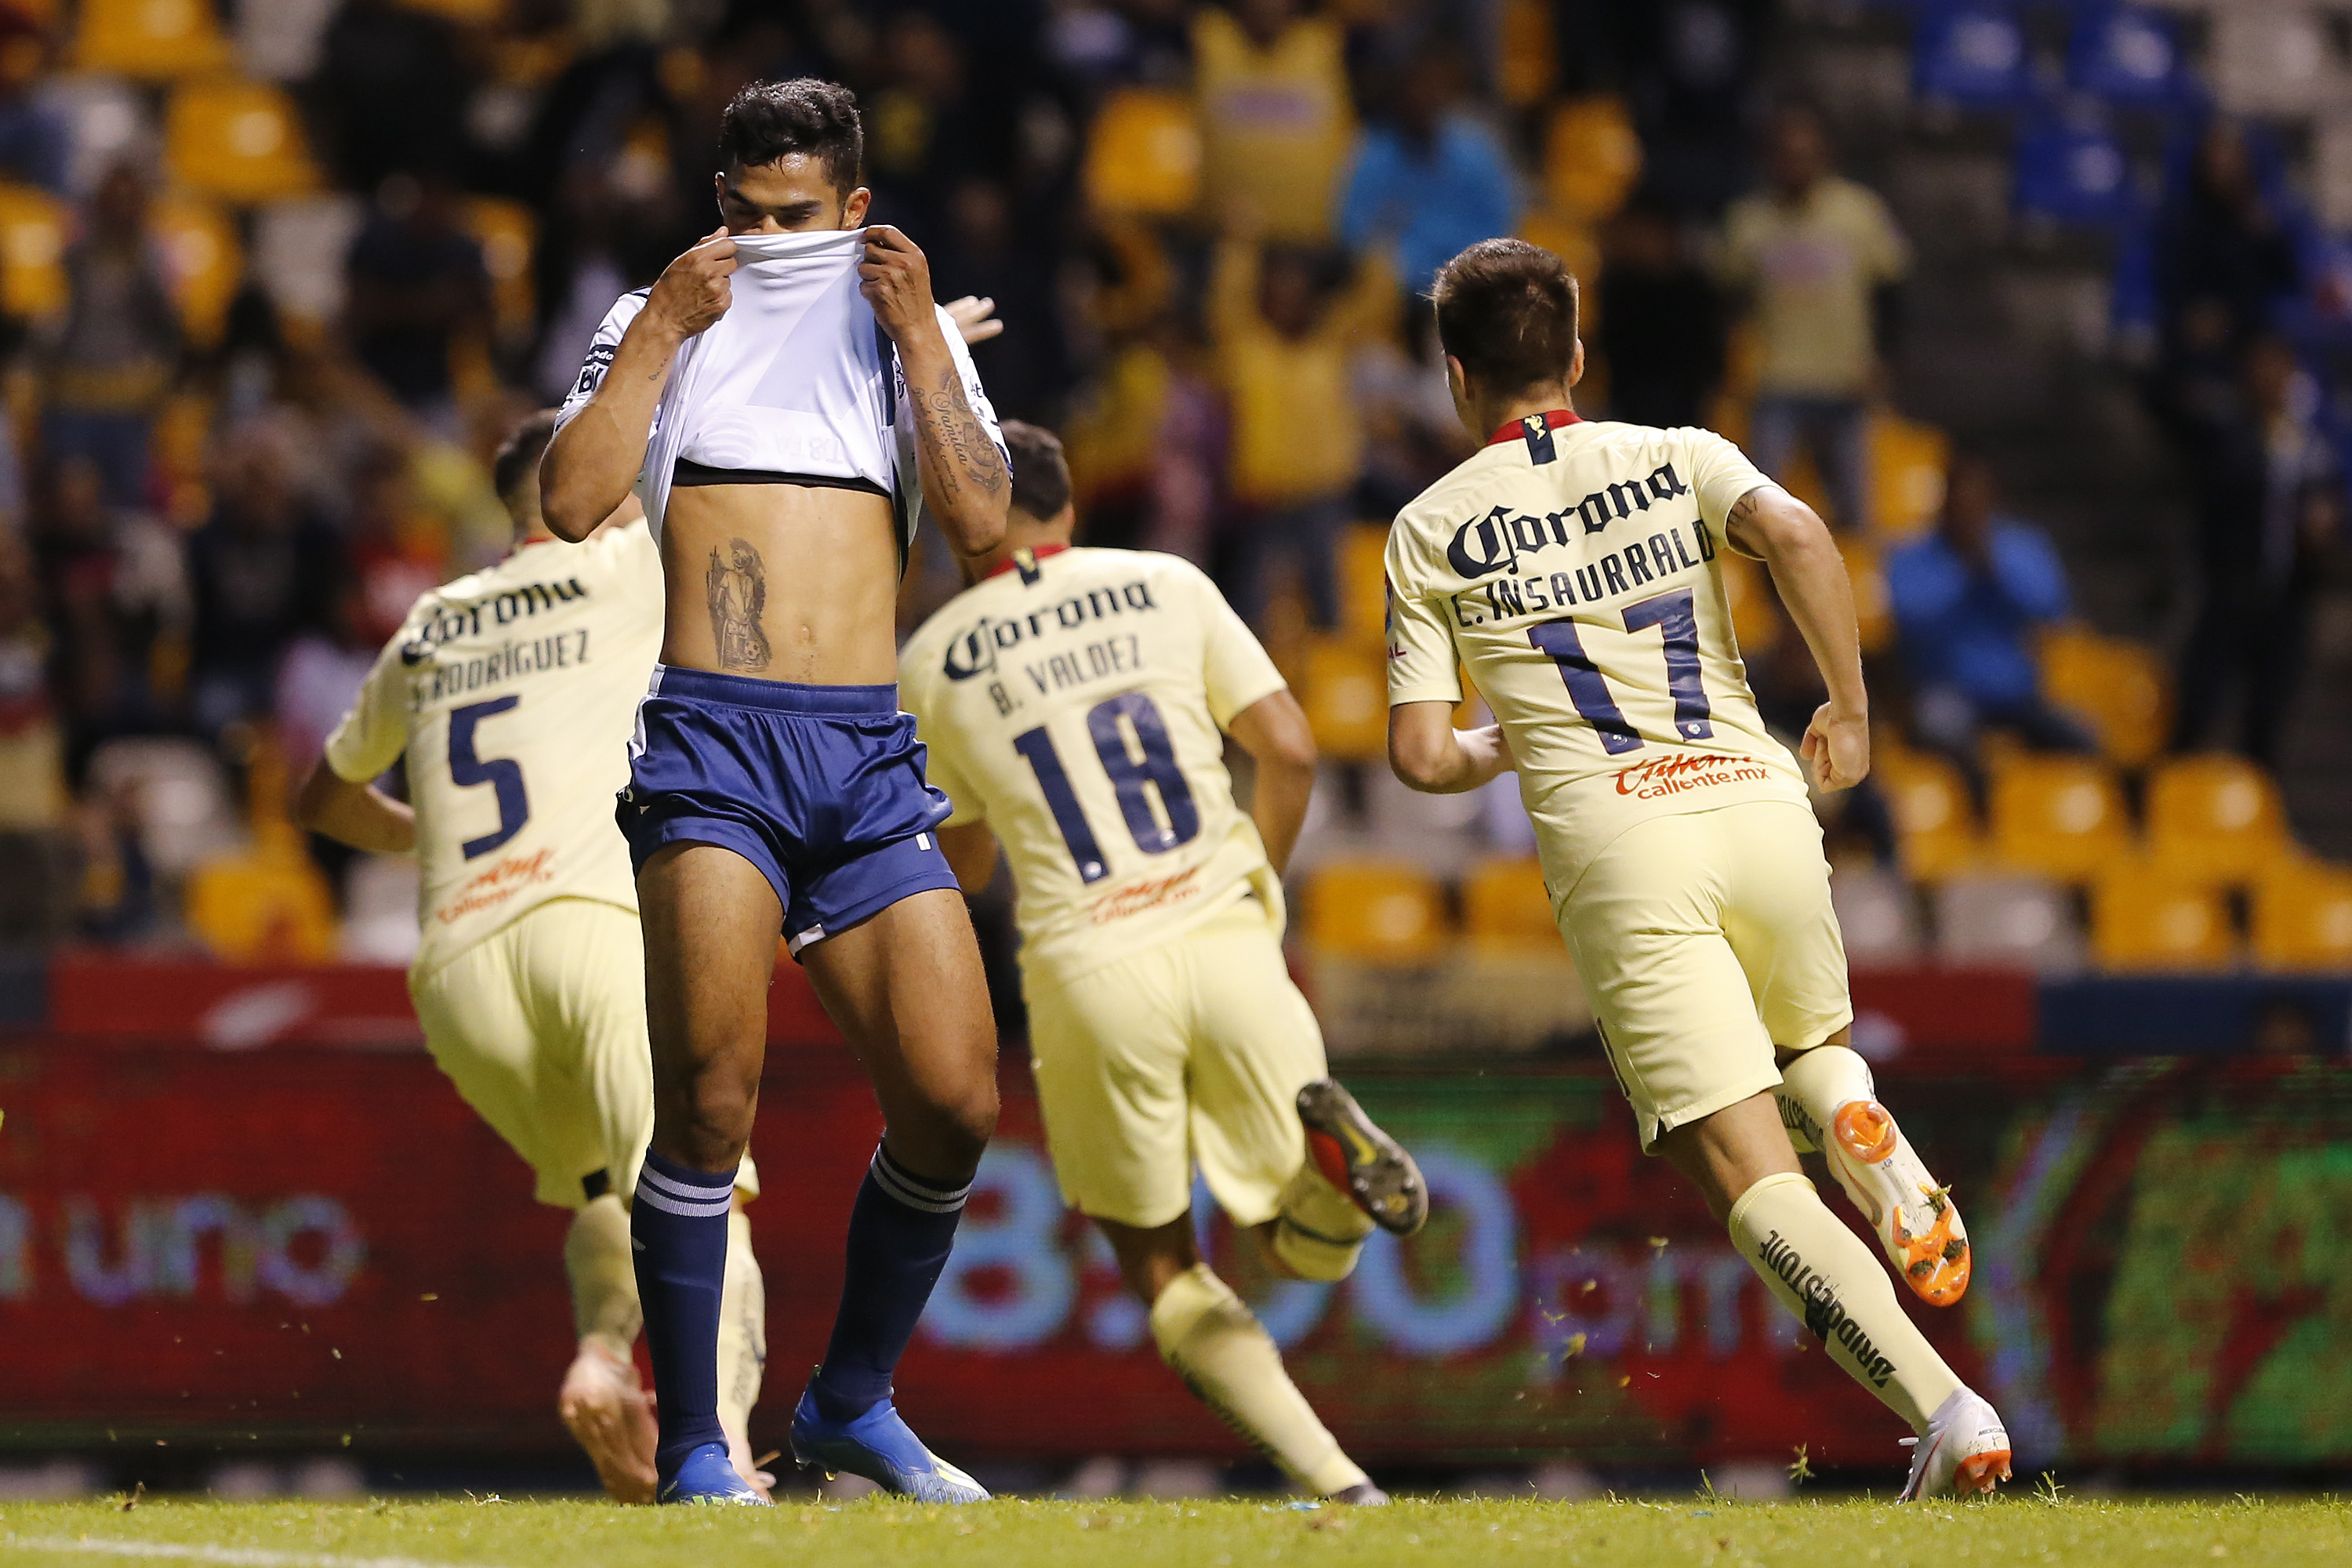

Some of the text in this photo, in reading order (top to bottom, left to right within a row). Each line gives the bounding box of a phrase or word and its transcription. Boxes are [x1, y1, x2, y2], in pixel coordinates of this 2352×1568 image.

[1446, 463, 1688, 579] Corona
[943, 582, 1158, 681] Corona
[1025, 633, 1143, 695] VALDEZ
[1526, 587, 1715, 755] 17
[448, 695, 532, 862] 5
[1013, 690, 1203, 887] 18
[1637, 767, 1772, 800] caliente.mx
[63, 1190, 368, 1308] uno
